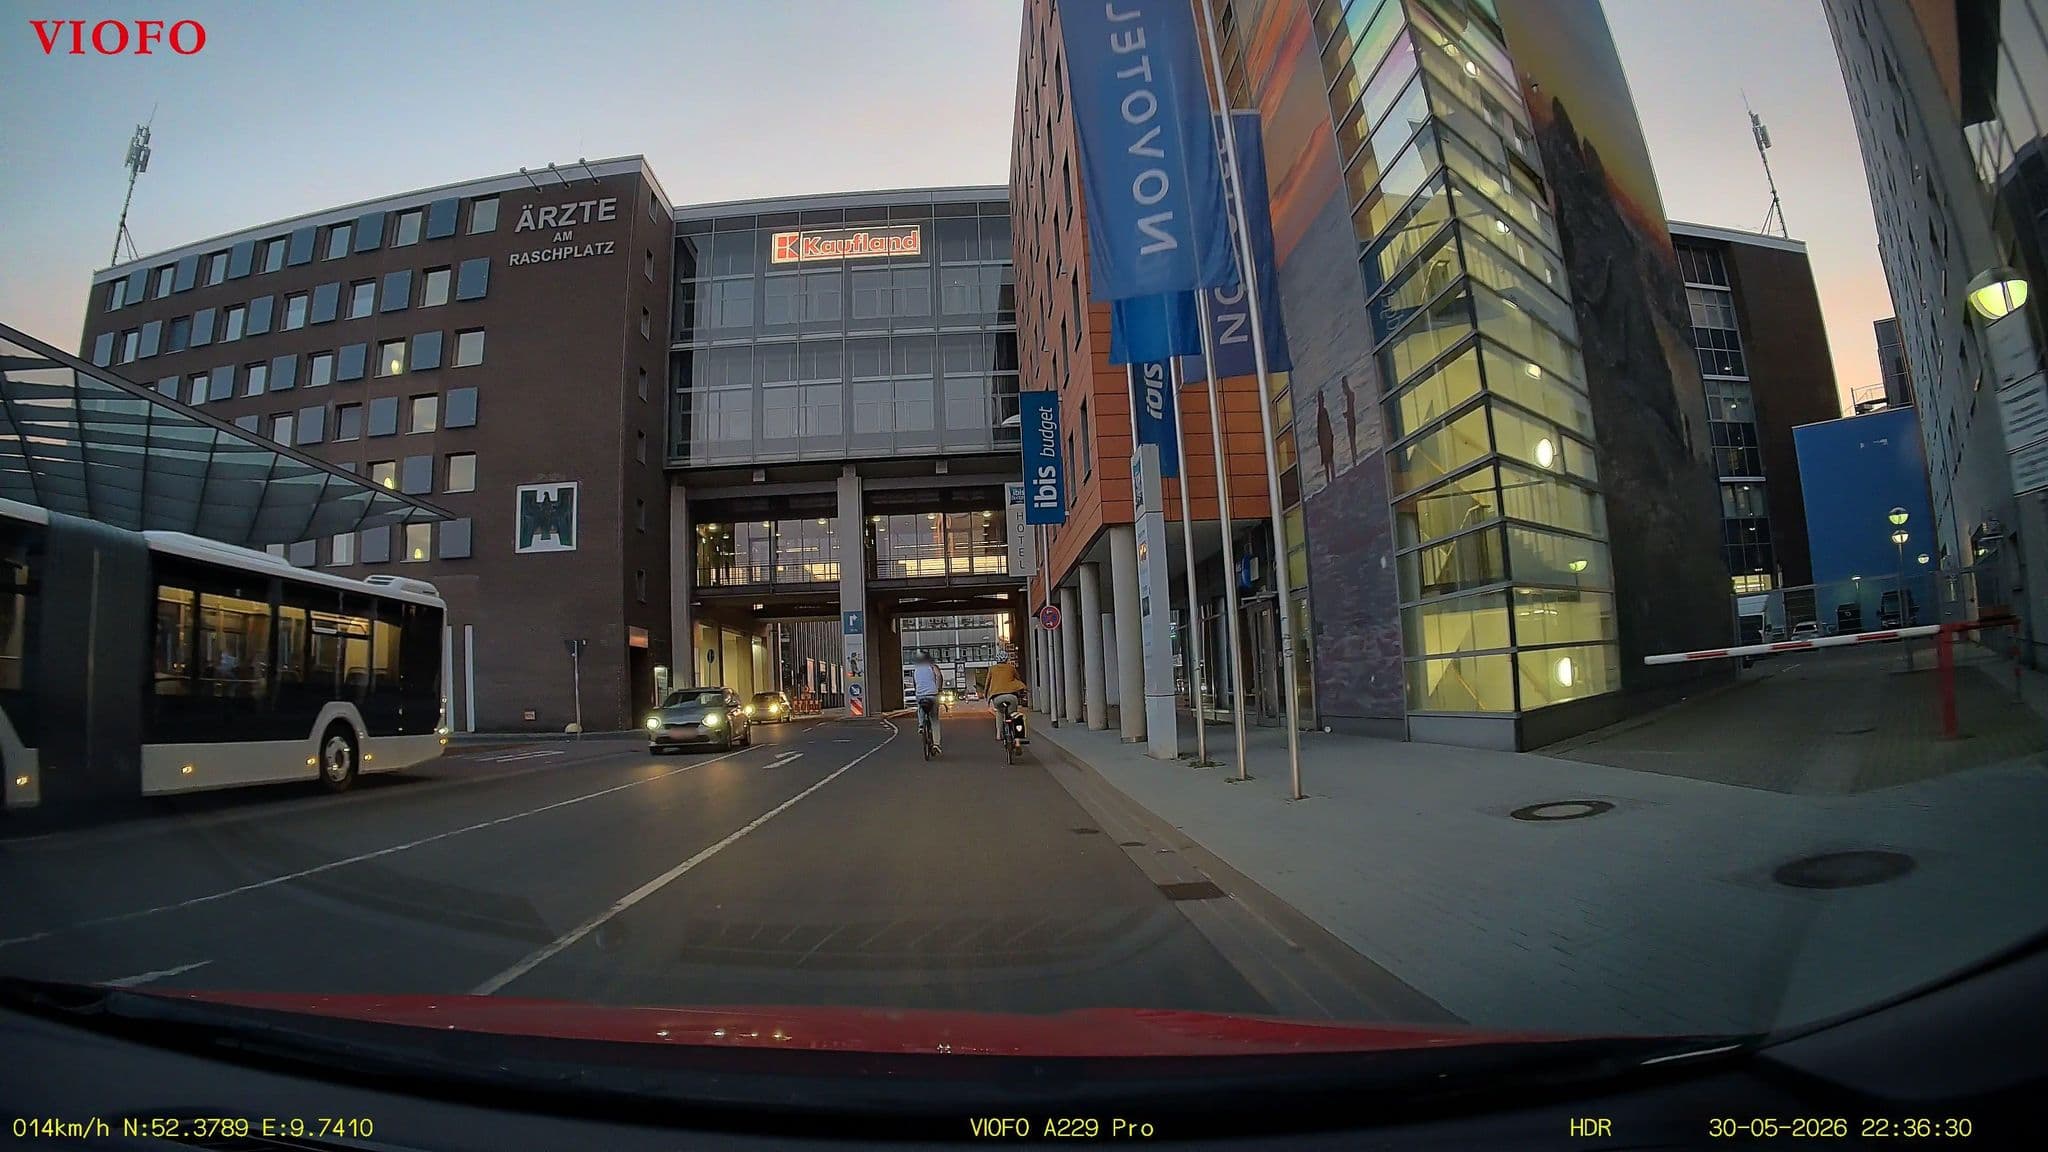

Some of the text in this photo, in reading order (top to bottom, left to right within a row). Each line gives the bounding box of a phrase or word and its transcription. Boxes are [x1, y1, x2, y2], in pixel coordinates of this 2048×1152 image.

[514, 197, 617, 233] ÄRZTE
[552, 230, 574, 242] AM
[802, 230, 918, 256] Kaufland
[509, 241, 615, 266] RASCHPLATZ
[1032, 406, 1058, 508] ibis budget
[1016, 511, 1025, 570] HOTEL
